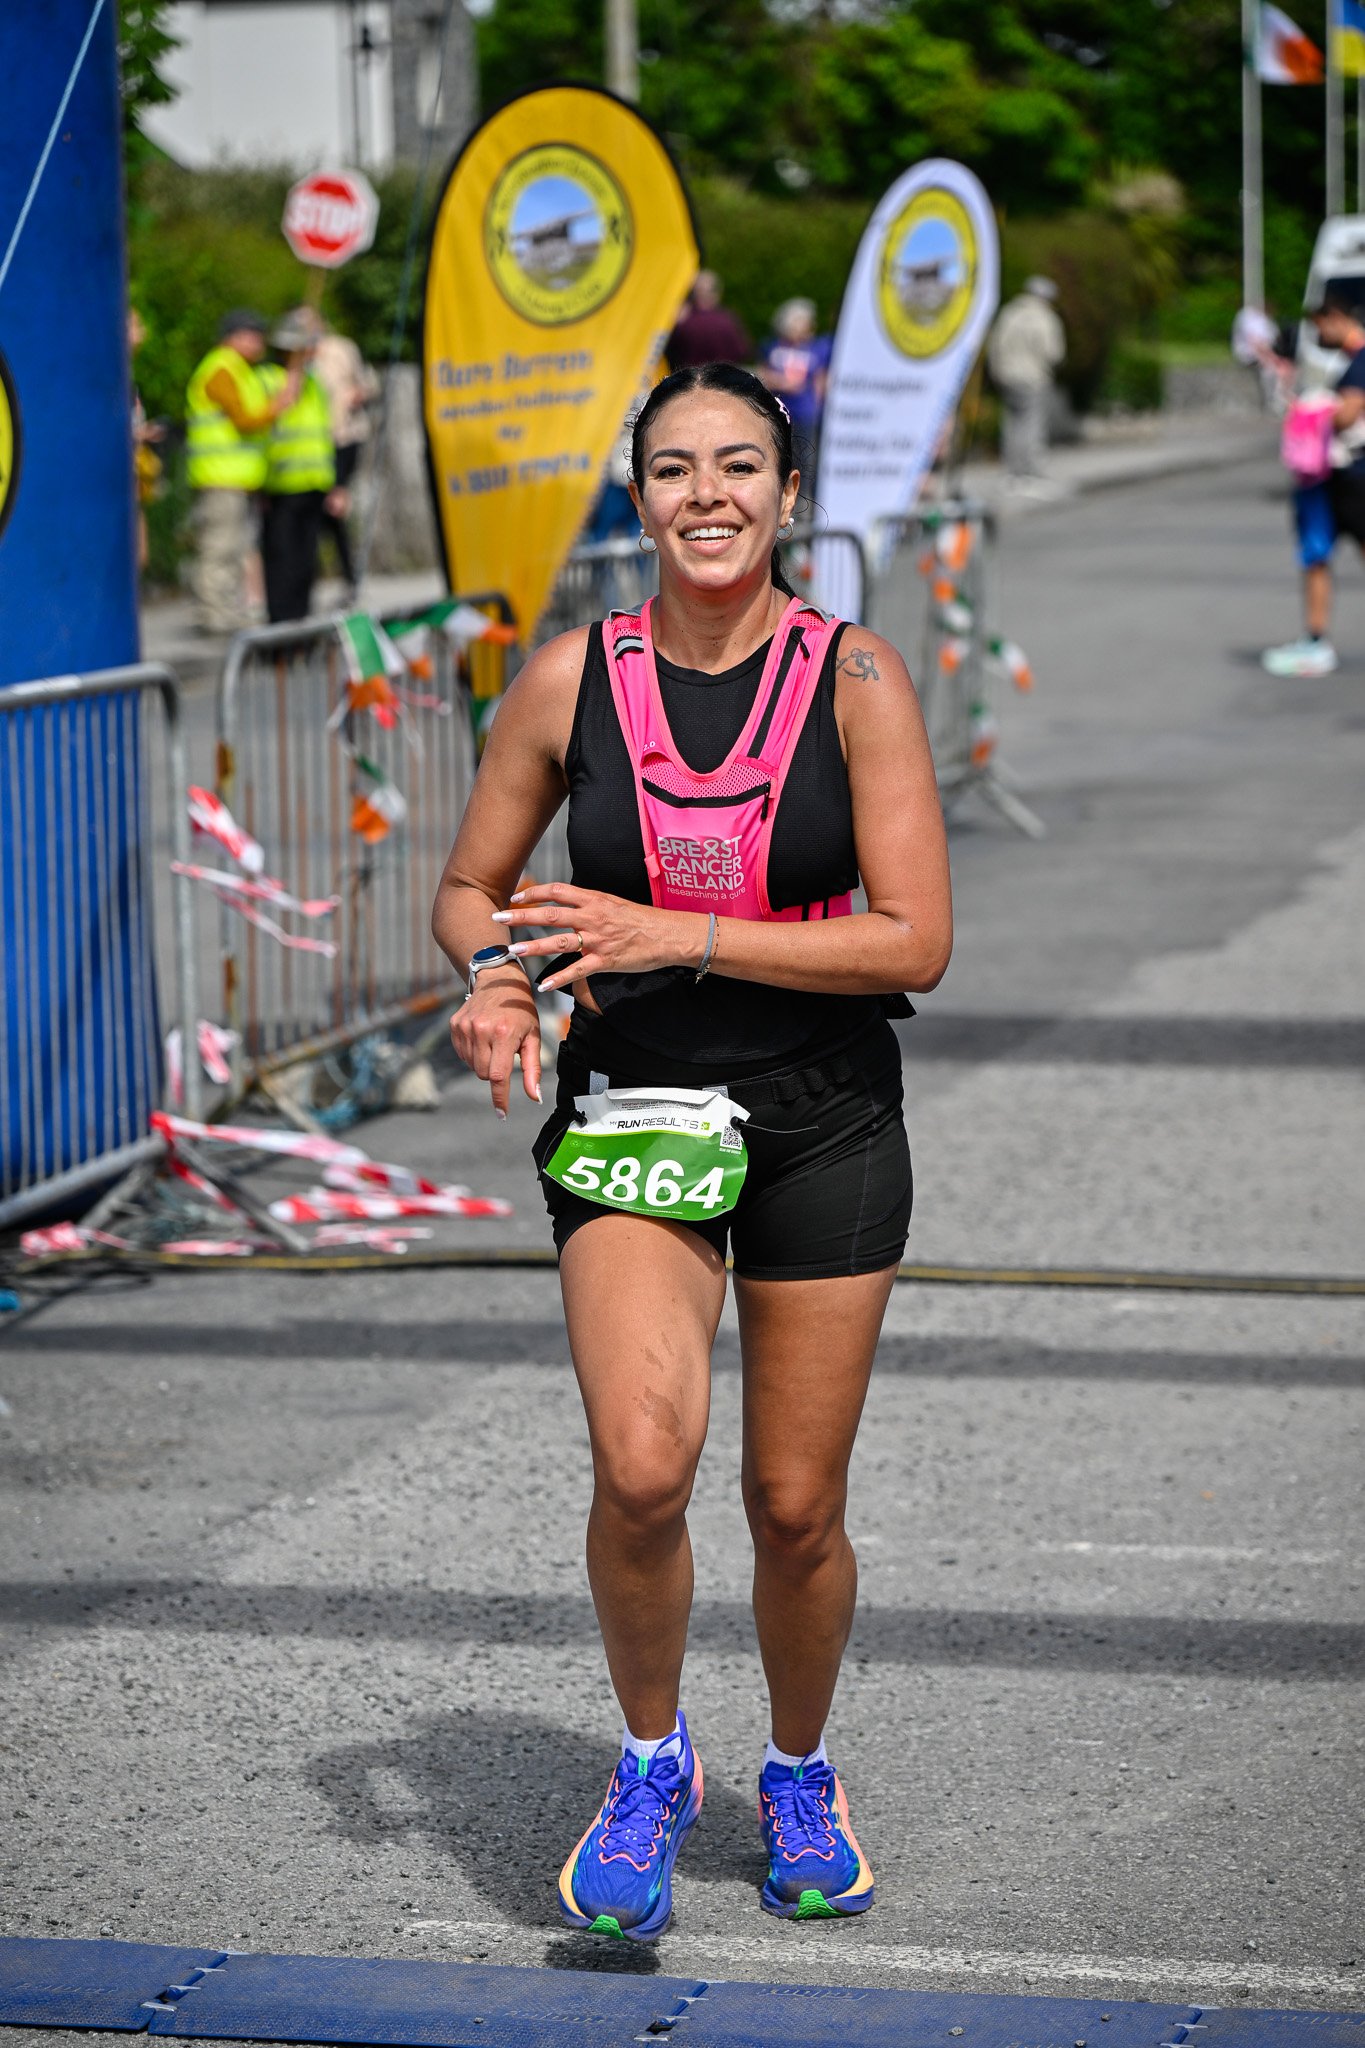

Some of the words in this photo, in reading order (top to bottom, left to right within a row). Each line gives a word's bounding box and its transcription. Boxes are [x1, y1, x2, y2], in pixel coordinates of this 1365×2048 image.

[286, 192, 359, 235] STOP
[660, 855, 743, 875] CANCER
[664, 871, 745, 891] IRELAND
[667, 887, 719, 901] researching
[729, 886, 746, 900] cure
[617, 1119, 641, 1129] RUN
[641, 1117, 699, 1130] RESULTS
[561, 1156, 725, 1209] 5864
